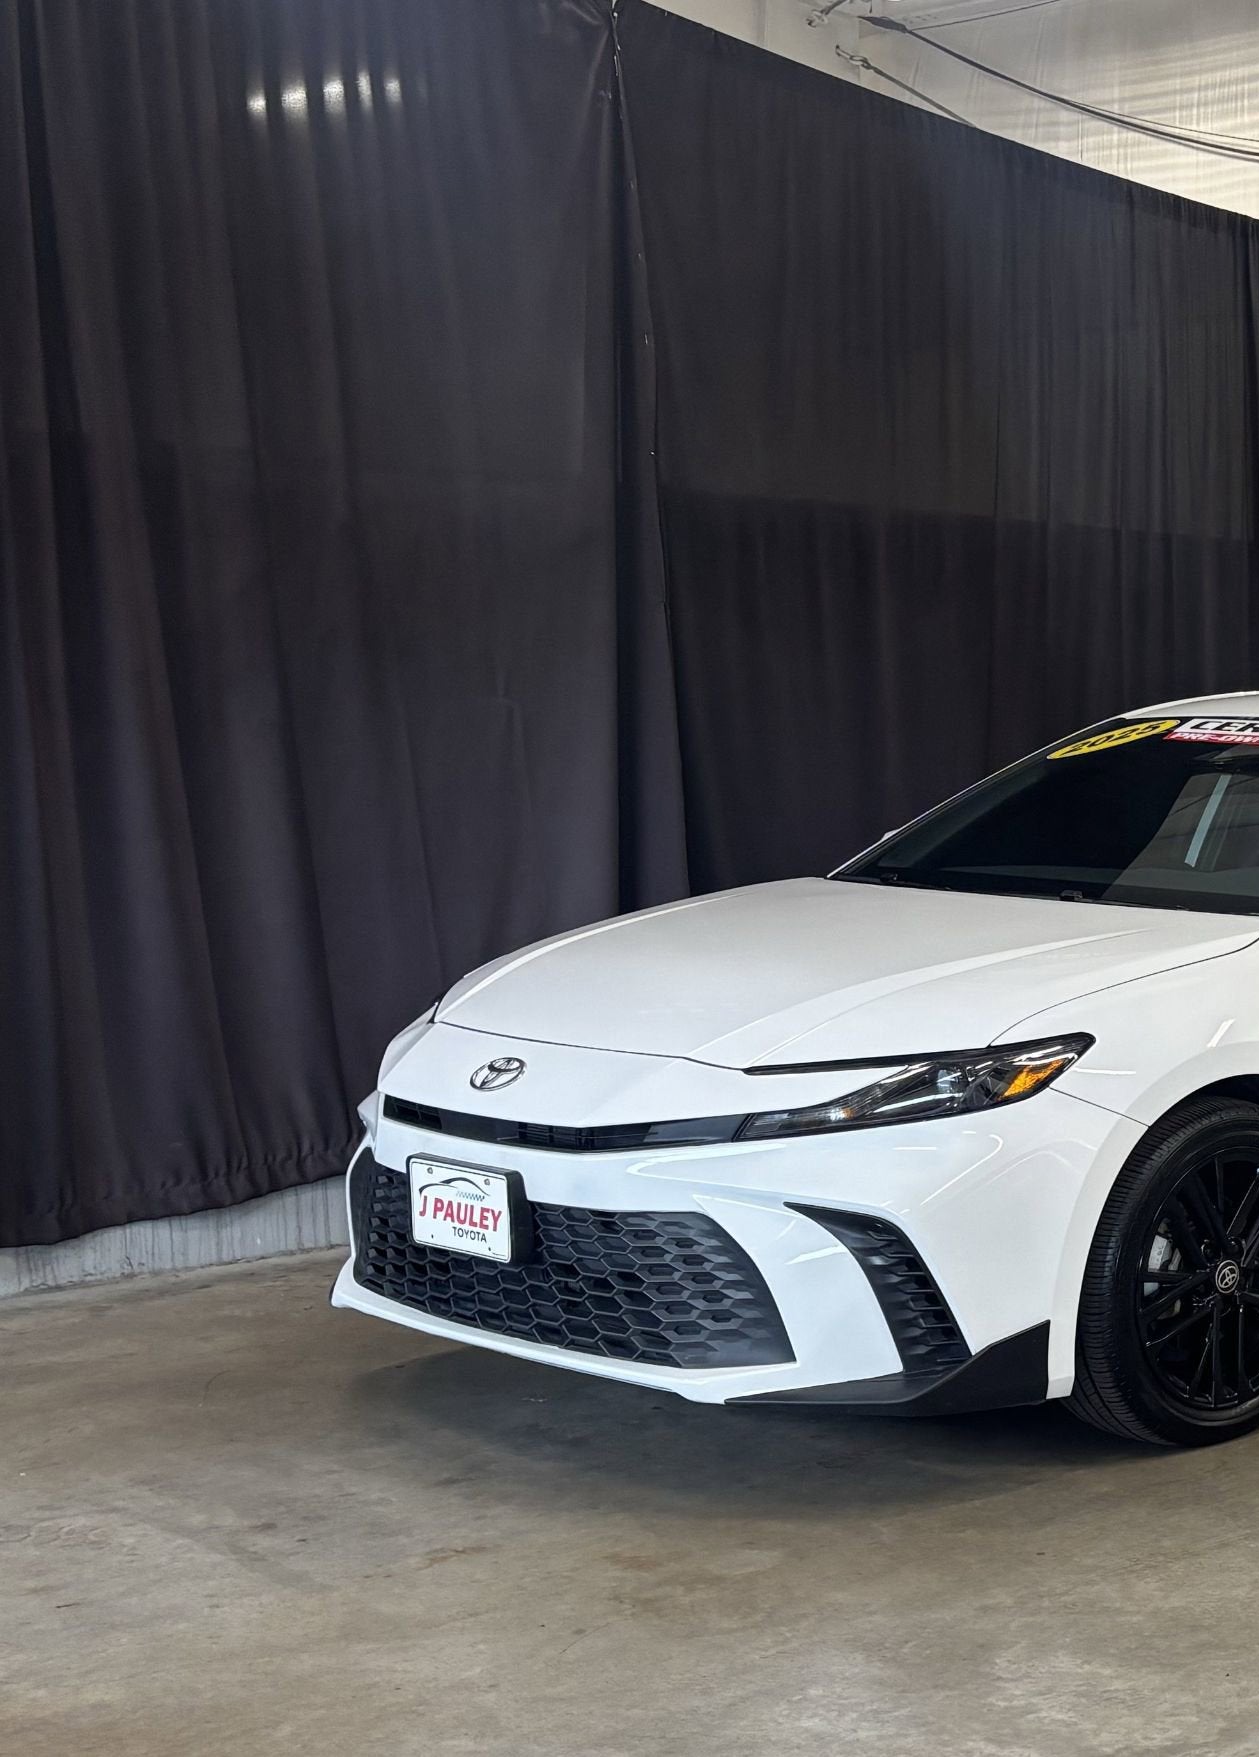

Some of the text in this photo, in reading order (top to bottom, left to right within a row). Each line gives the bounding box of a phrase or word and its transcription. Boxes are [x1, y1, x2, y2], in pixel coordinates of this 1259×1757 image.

[1061, 721, 1167, 755] 2025
[419, 1195, 502, 1232] J PAULEY
[451, 1226, 487, 1243] TOYOTA
